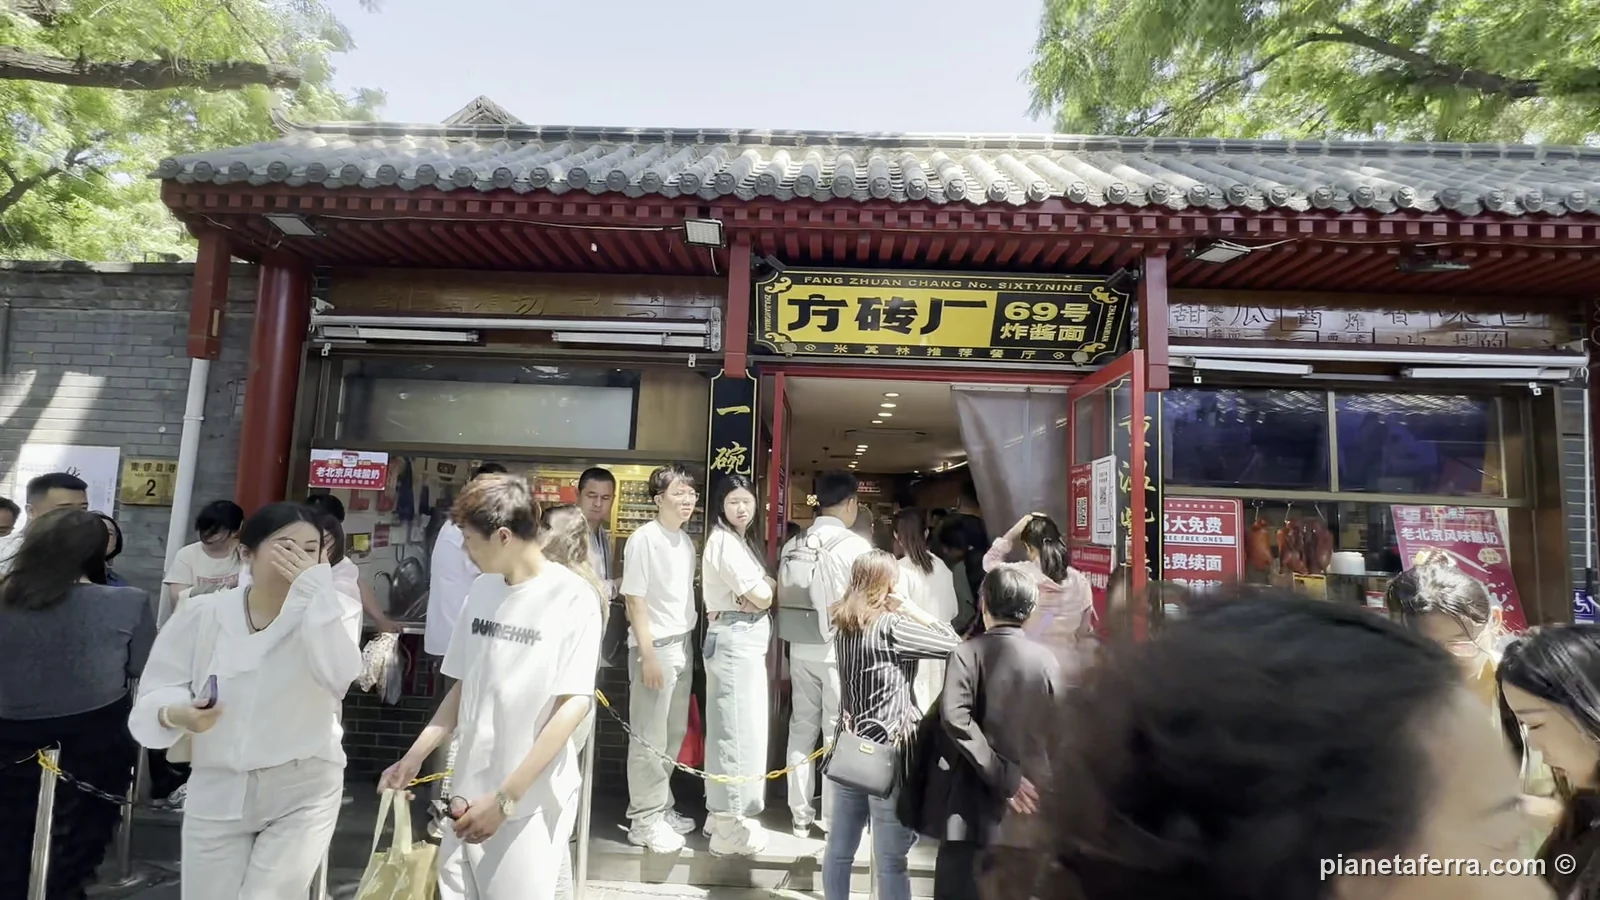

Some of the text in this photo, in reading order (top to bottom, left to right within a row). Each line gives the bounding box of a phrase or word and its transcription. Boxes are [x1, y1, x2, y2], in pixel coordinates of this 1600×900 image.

[804, 276, 1084, 291] FANG ZHUAN CHANG No. SIXTYNINE
[787, 293, 988, 335] 方砖厂
[1004, 301, 1091, 322] 69号
[1000, 322, 1087, 342] 炸酱面
[1101, 304, 1117, 342] ZHAJIANGMIAN
[710, 405, 751, 475] 一碗
[316, 467, 380, 480] 老北京风味酸奶
[145, 478, 156, 497] 2
[1202, 535, 1224, 543] ONES
[1401, 526, 1499, 545] 老北京风味酸奶
